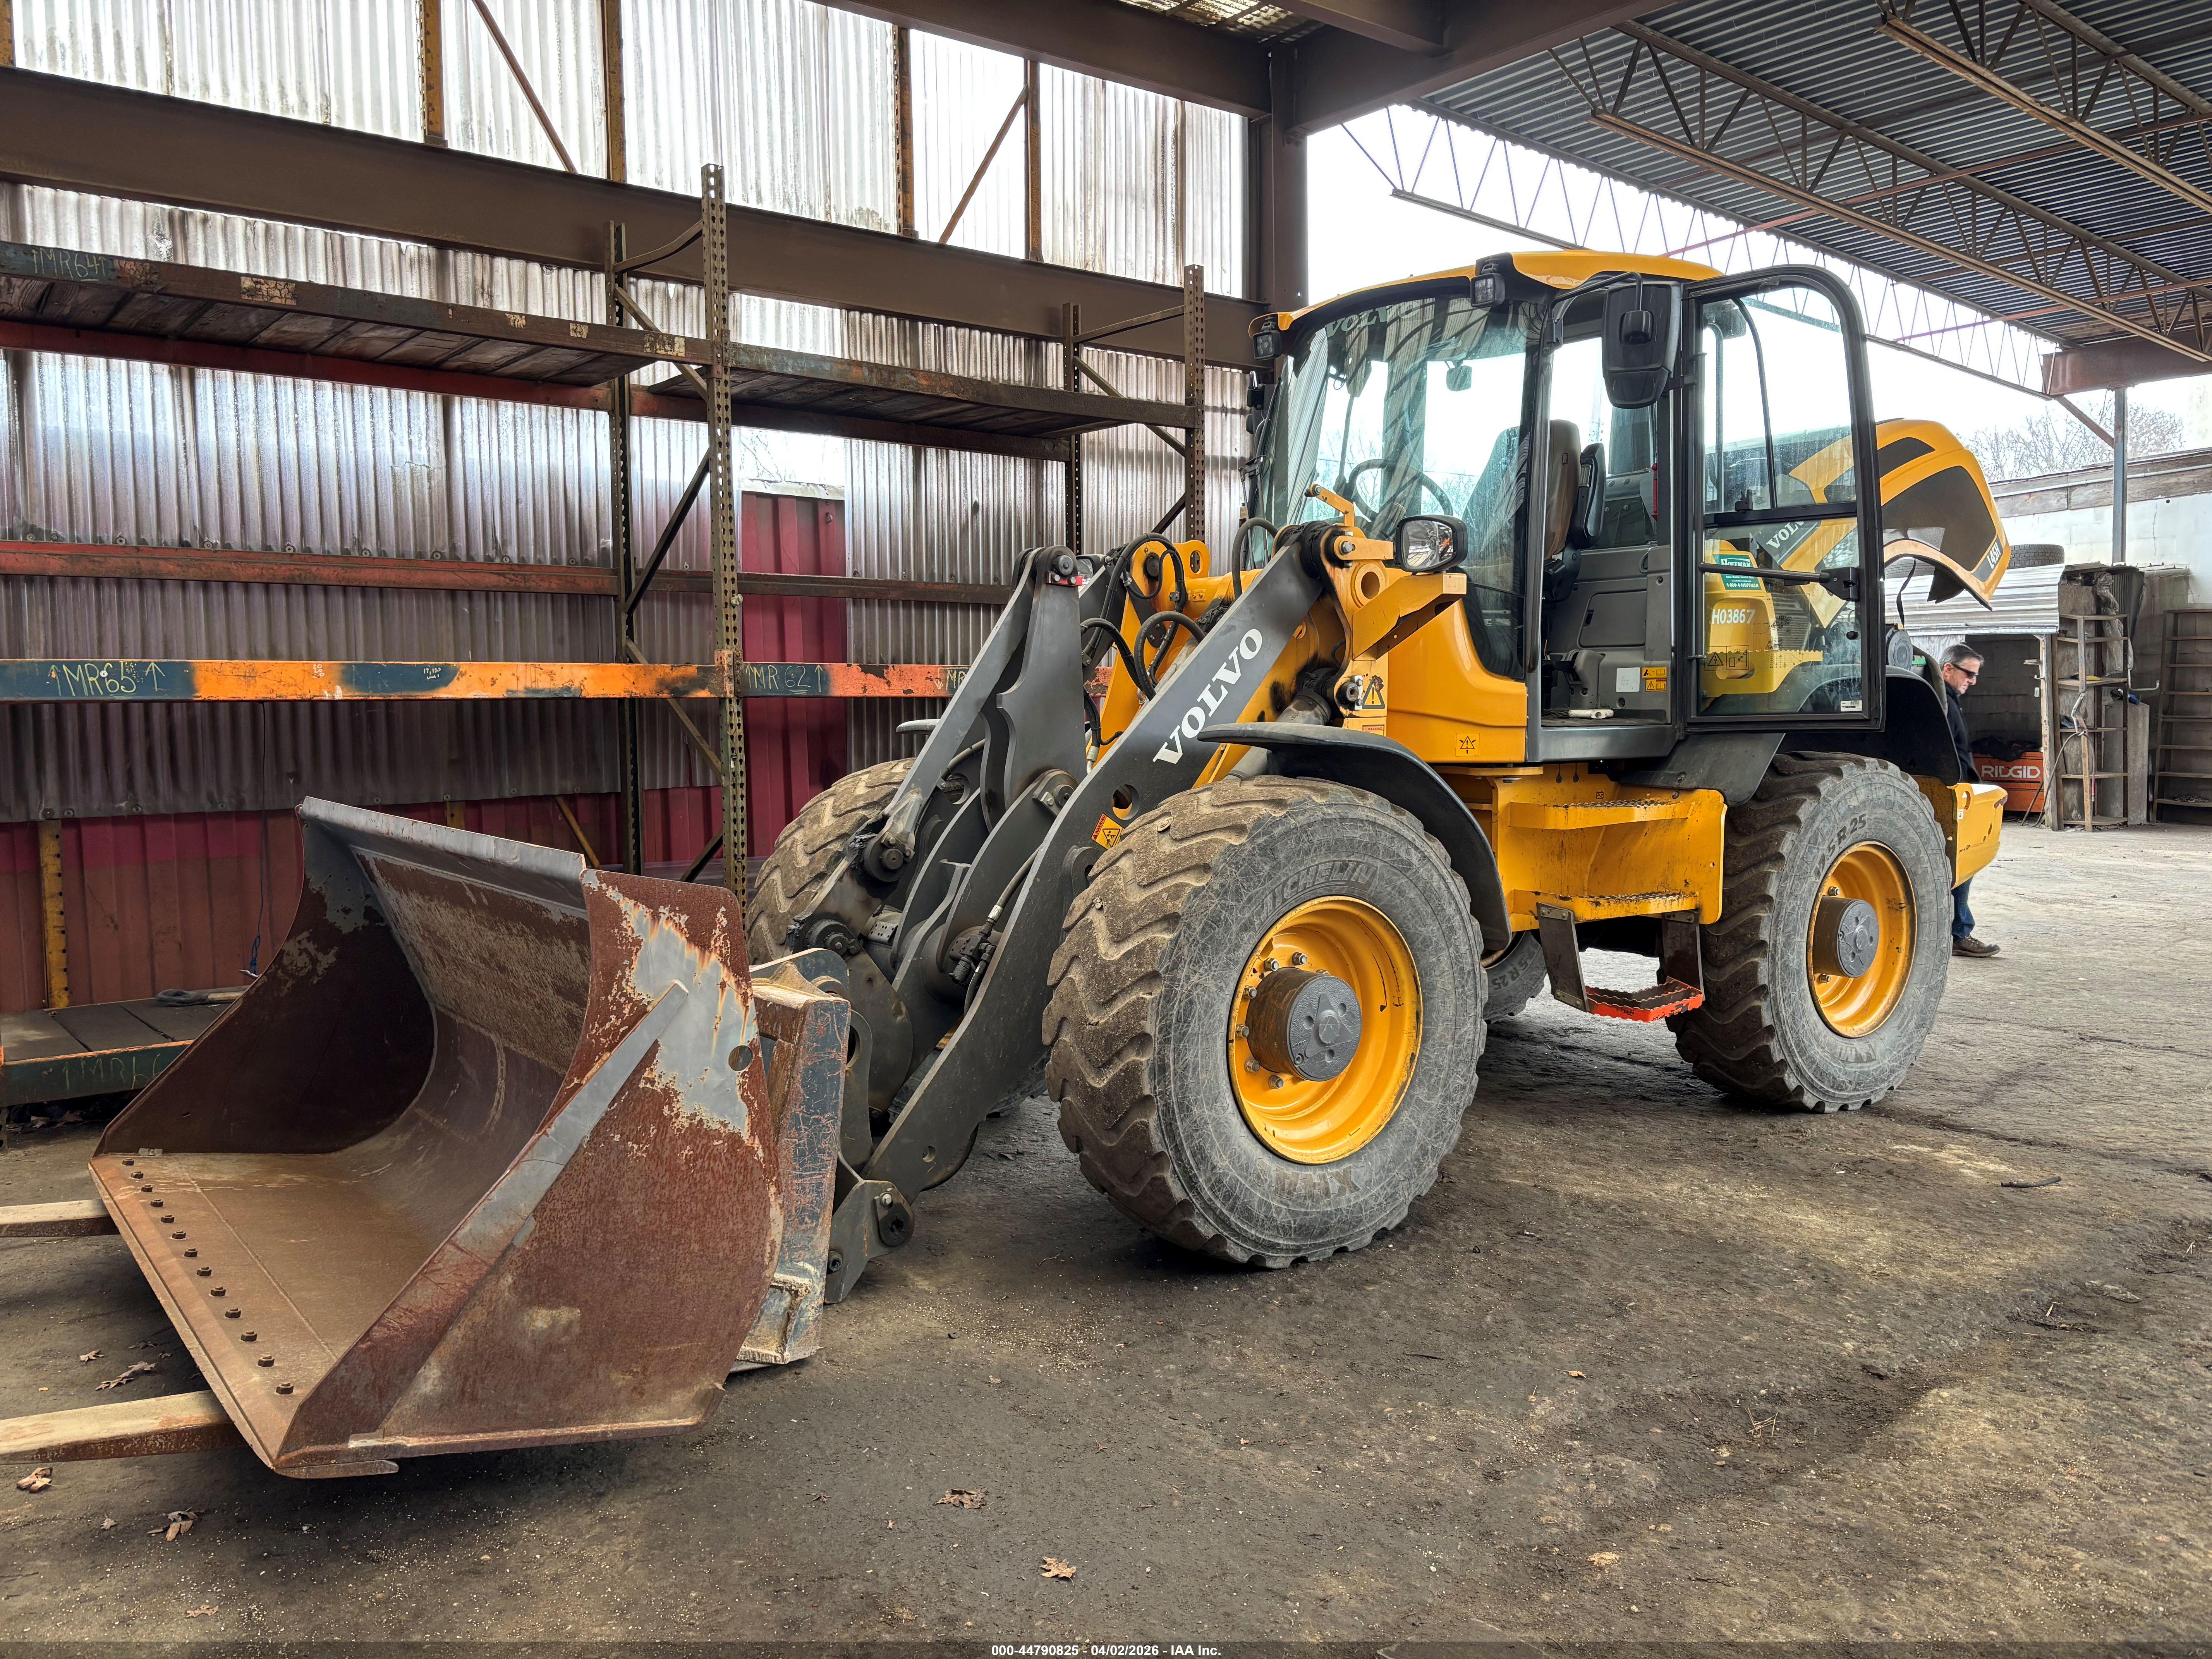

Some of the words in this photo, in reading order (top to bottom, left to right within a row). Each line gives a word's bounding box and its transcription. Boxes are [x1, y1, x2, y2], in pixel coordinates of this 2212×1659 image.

[1325, 302, 1420, 338] VOLVO
[1987, 542, 2001, 569] L45H
[1712, 609, 1755, 625] H03867
[1153, 629, 1262, 764] VOLVO
[1981, 765, 2041, 778] RIDGID
[1850, 814, 1867, 834] 25
[1254, 861, 1376, 931] MICHELIN
